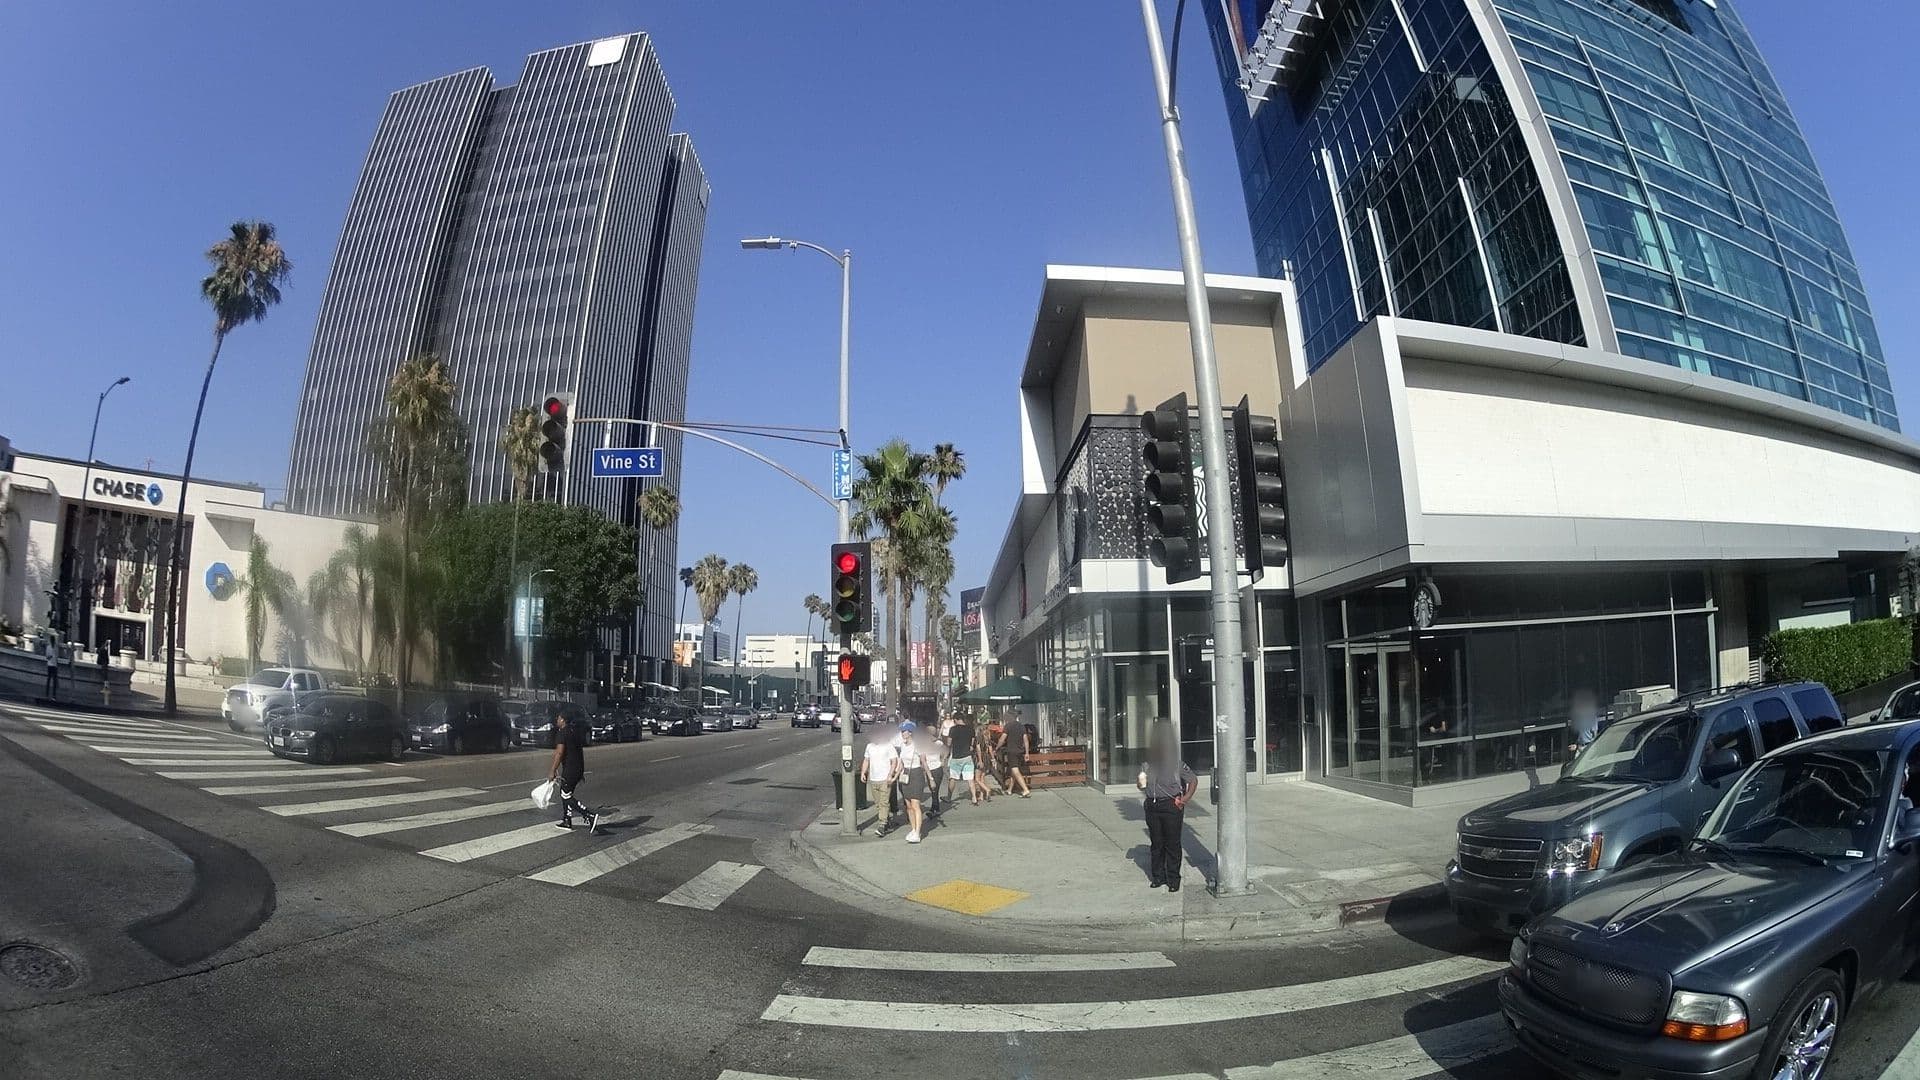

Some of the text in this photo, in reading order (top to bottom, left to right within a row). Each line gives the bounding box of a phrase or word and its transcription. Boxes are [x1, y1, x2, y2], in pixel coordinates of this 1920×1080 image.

[601, 454, 656, 470] Vine St
[93, 477, 146, 502] CHASE
